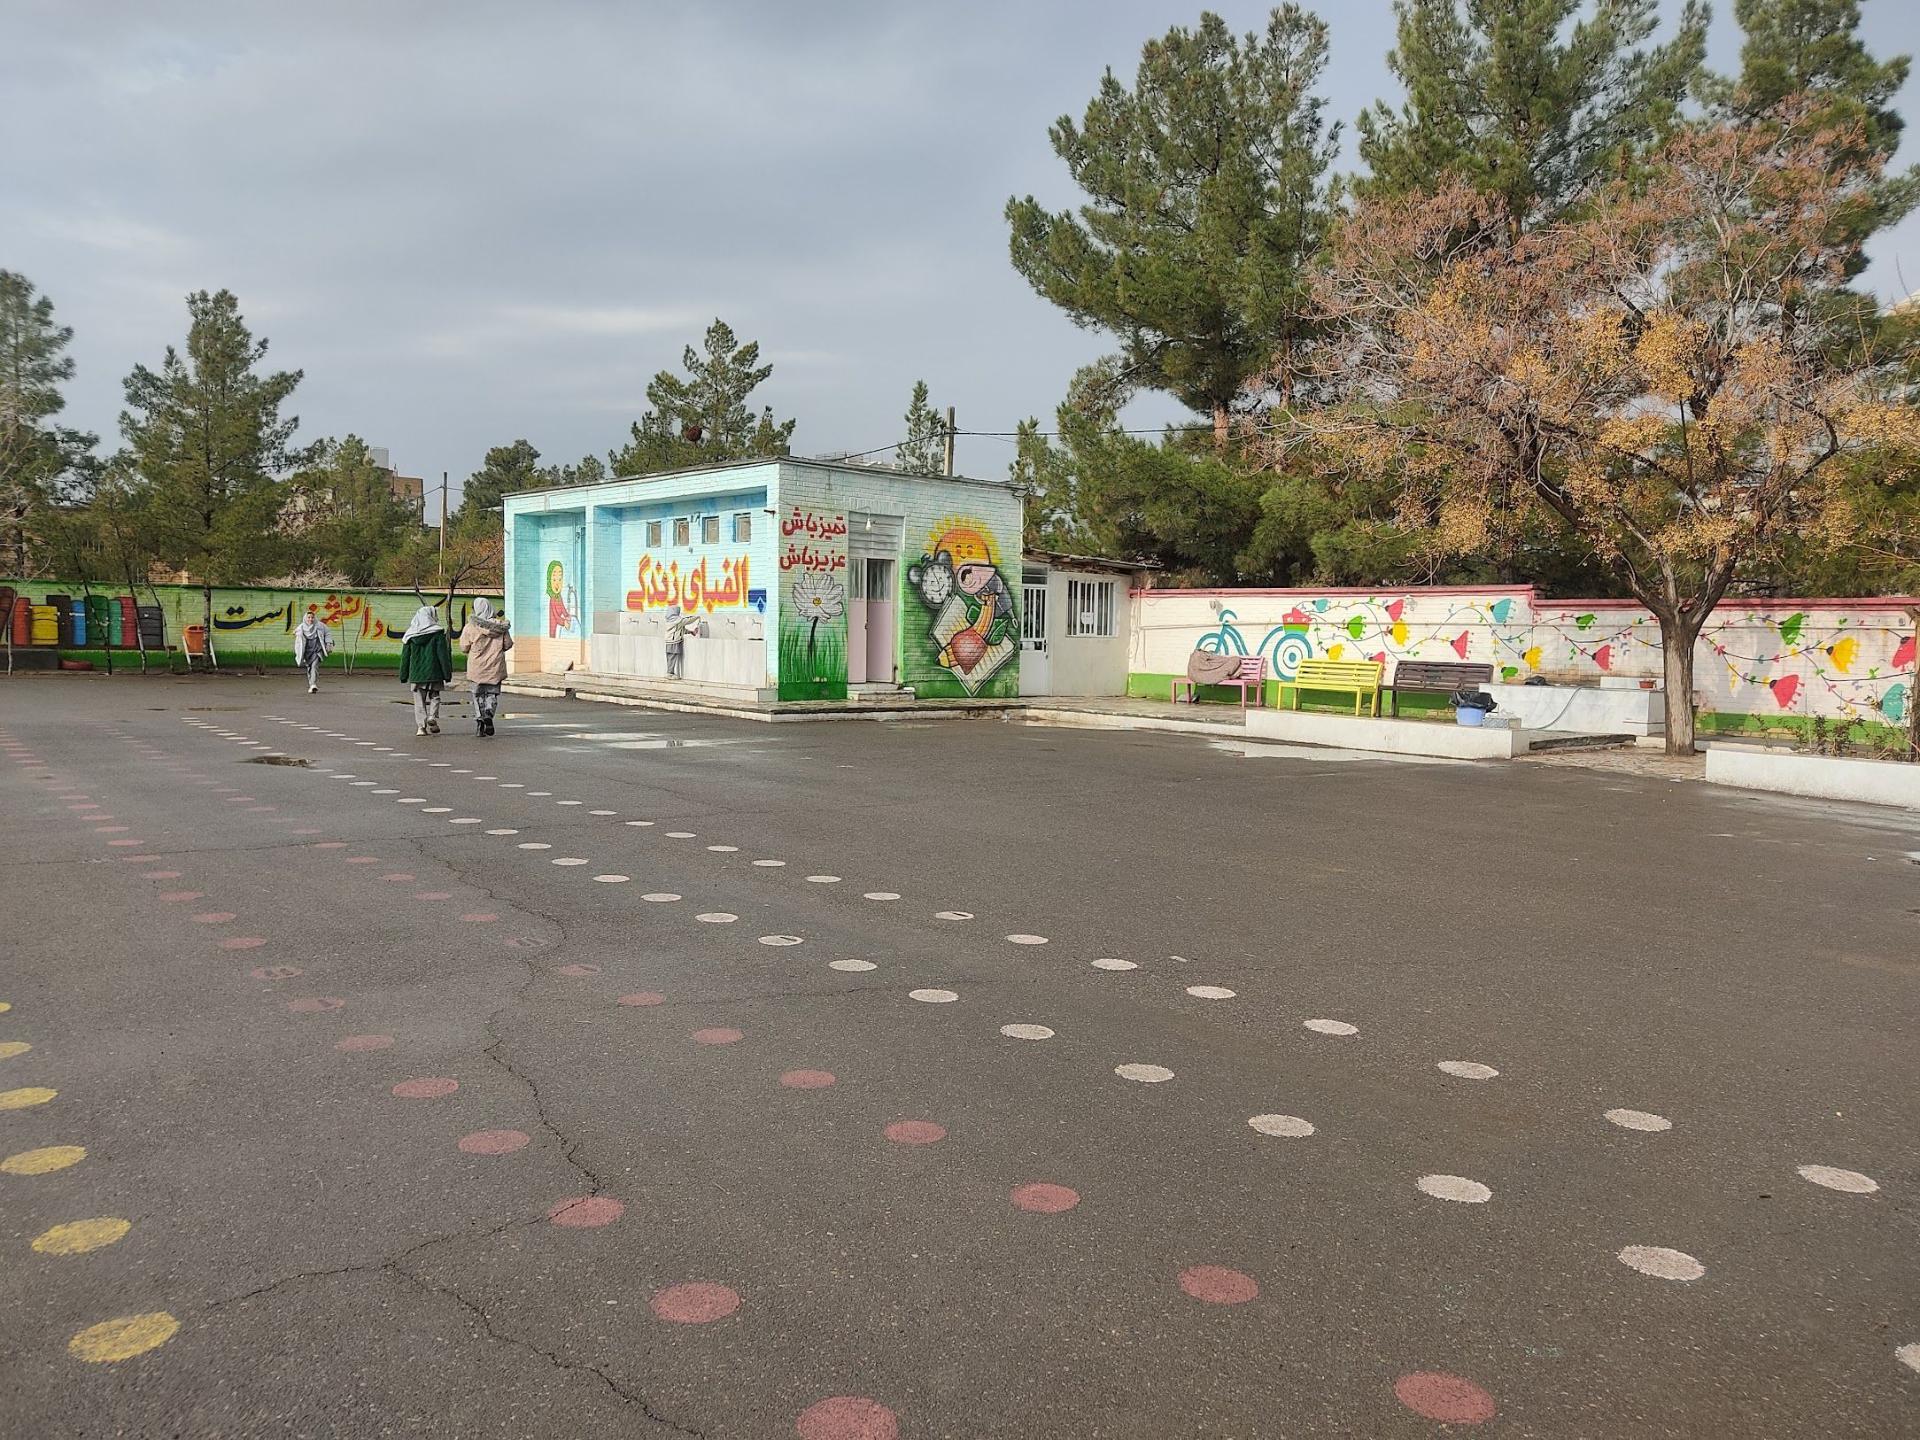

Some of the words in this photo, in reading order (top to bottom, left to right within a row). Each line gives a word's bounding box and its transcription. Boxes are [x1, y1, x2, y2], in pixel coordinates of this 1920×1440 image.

[782, 506, 818, 538] باش
[819, 516, 847, 540] تمیز
[779, 543, 814, 571] باش
[812, 550, 846, 572] عزیز
[626, 552, 680, 613] زندگی
[682, 552, 750, 614] الفبای
[213, 601, 294, 632] است
[307, 594, 384, 640] دانشم
